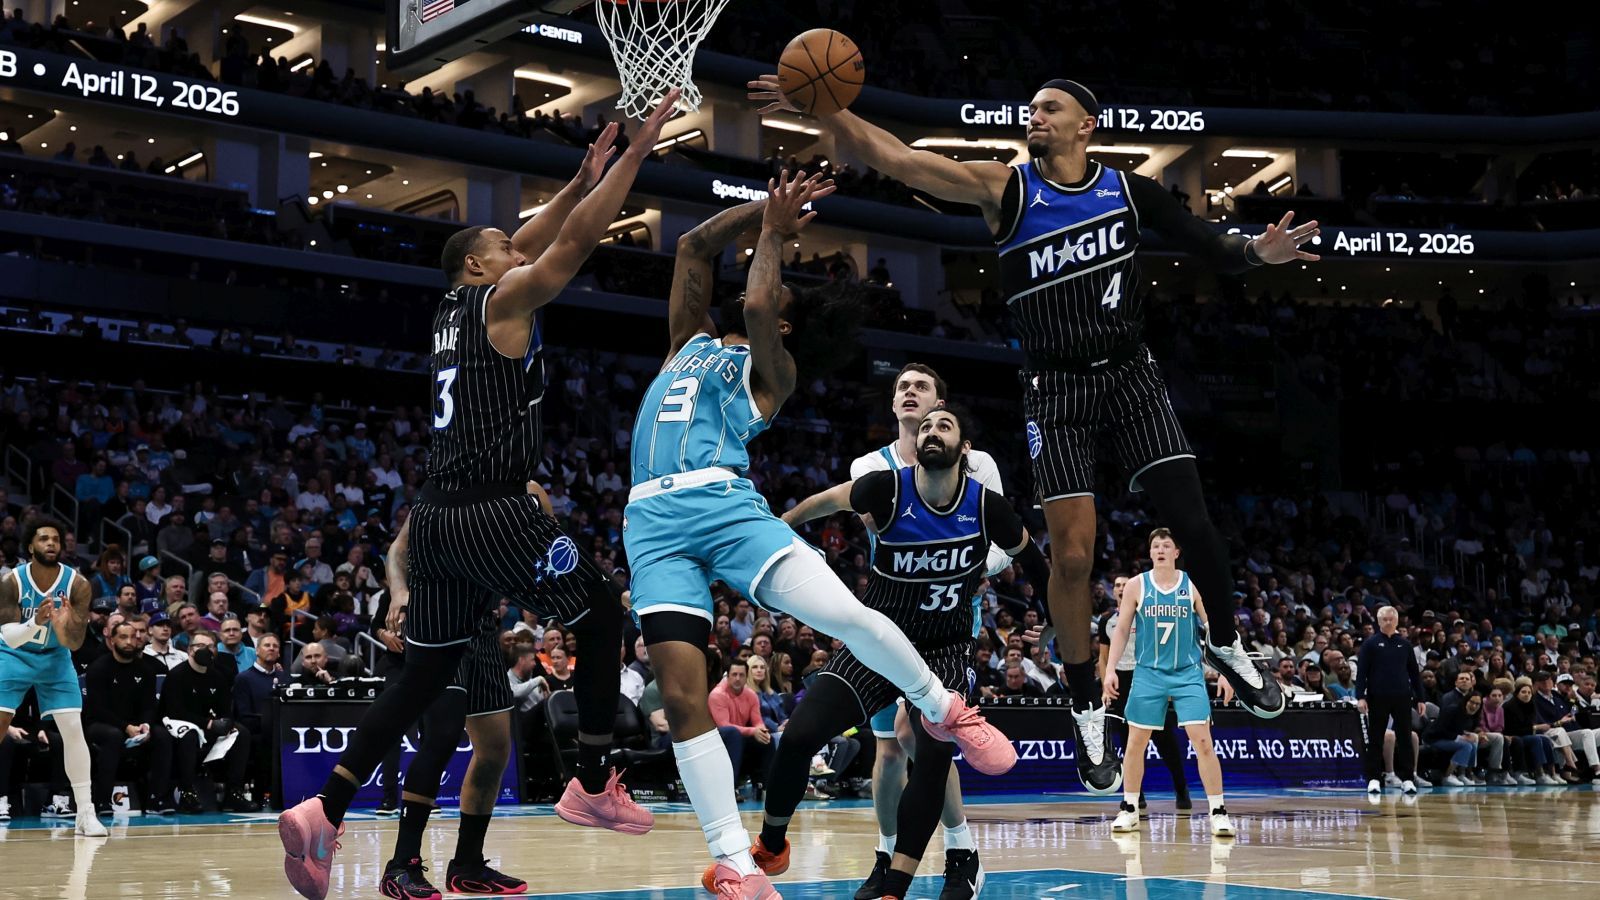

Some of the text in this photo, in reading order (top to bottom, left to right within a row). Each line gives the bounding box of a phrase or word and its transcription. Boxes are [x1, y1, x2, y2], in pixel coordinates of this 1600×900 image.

[539, 24, 582, 44] CENTER
[0, 50, 240, 116] B April 12, 2026
[960, 104, 1012, 125] Cardi
[1097, 108, 1113, 128] ril
[1118, 109, 1145, 131] 12,
[1151, 110, 1205, 131] 2026
[712, 179, 769, 200] Spectrum
[1094, 188, 1120, 198] Disney
[1333, 231, 1474, 255] April 12, 2026
[1101, 272, 1122, 309] 4
[434, 327, 459, 354] BANE
[433, 367, 458, 429] 3
[657, 376, 699, 422] 3
[956, 514, 977, 524] Disney
[920, 583, 963, 611] 35
[1144, 605, 1188, 618] HORNETS
[1157, 622, 1175, 645] 7
[1186, 739, 1359, 759] AAVE. NO EXTRAS.
